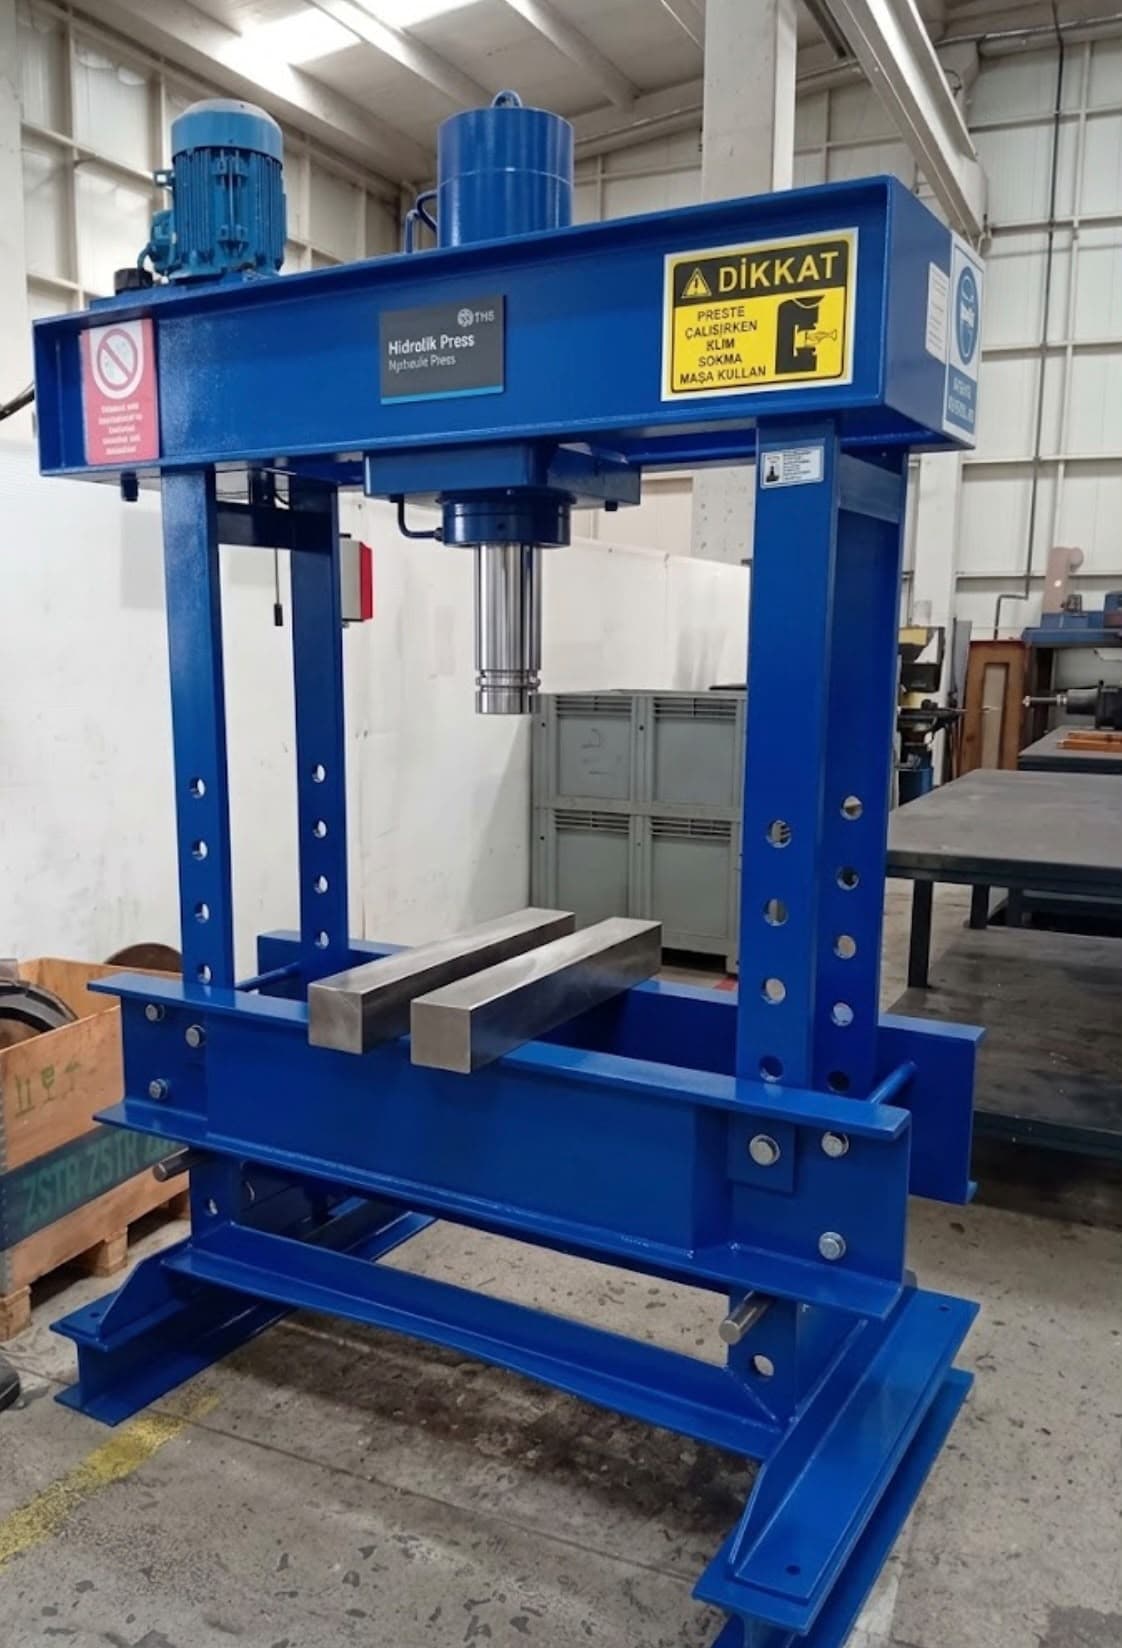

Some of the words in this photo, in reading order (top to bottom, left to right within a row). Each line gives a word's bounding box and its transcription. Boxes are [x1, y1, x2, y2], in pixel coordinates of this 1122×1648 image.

[718, 251, 839, 292] DİKKAT
[697, 306, 745, 322] PRESTE
[388, 336, 437, 355] Hidrolik
[440, 334, 475, 349] Press
[698, 353, 743, 368] SOKMA
[680, 371, 714, 385] MAŞA
[718, 366, 766, 382] KULLAN
